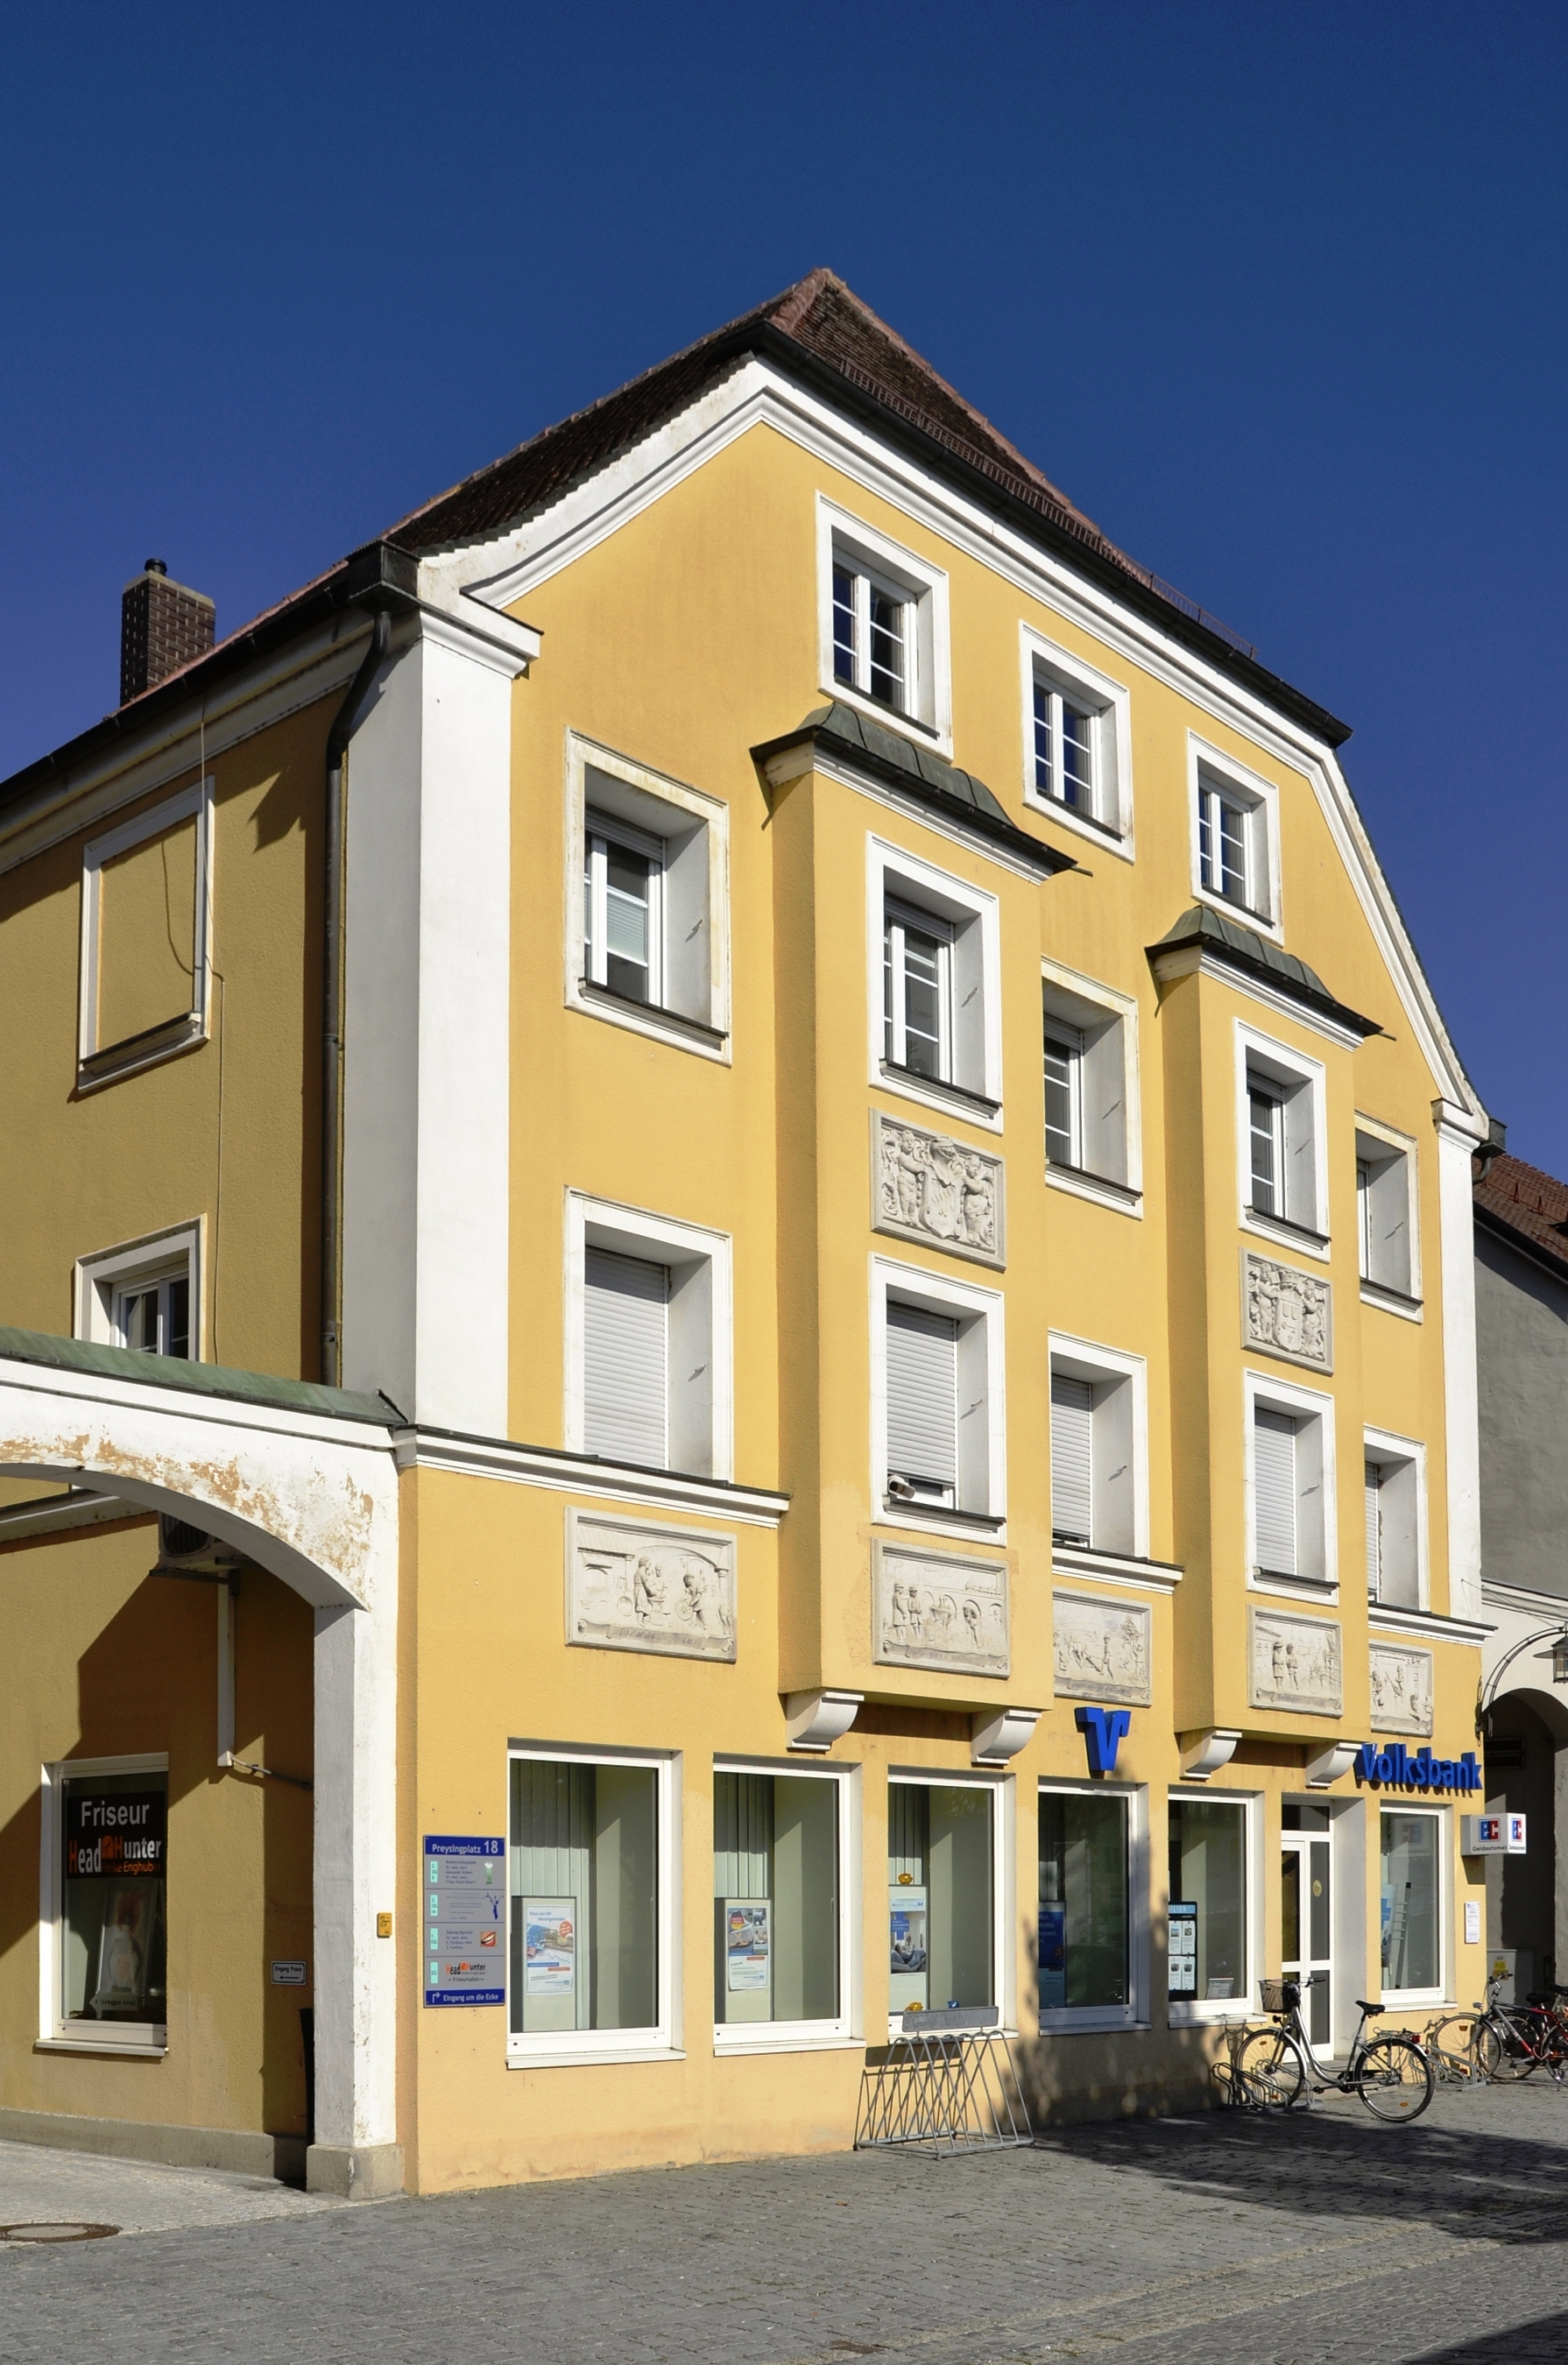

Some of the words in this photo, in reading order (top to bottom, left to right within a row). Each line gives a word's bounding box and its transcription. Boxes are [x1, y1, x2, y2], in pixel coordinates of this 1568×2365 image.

[1358, 1742, 1483, 1790] Volksbank
[81, 1800, 150, 1827] Friseur
[69, 1838, 102, 1874] Head
[115, 1836, 162, 1859] Hunter
[432, 1844, 482, 1855] Preysingplatz
[484, 1839, 498, 1854] 18
[445, 1963, 461, 1975] Head
